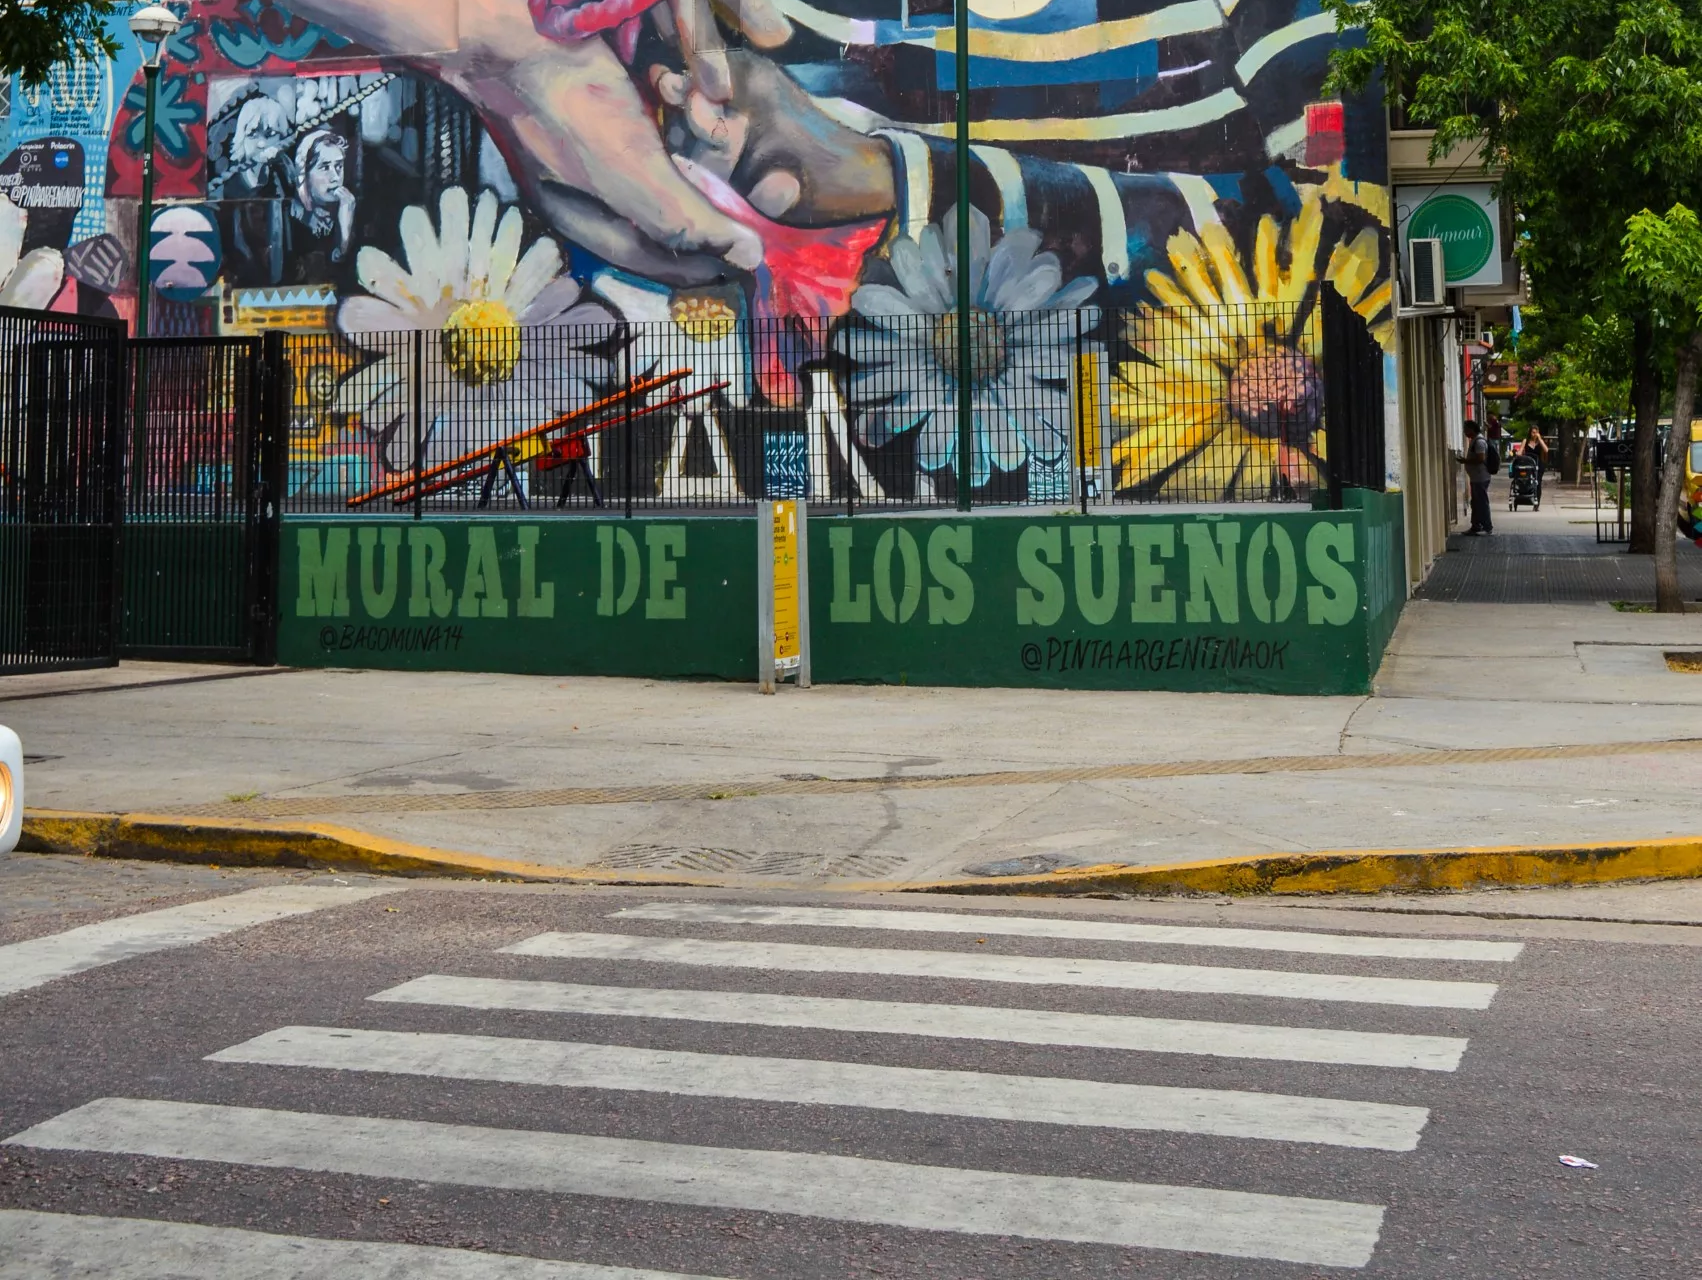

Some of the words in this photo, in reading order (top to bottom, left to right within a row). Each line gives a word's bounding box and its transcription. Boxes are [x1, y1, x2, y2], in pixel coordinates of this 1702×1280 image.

[296, 525, 555, 619] MURAL
[597, 525, 687, 619] DE
[829, 525, 975, 626] LOS
[1016, 514, 1359, 627] SUEÑOS
[319, 623, 464, 653] @BACOMUNA14
[1020, 635, 1290, 672] @PINTAARGENTINAOK
